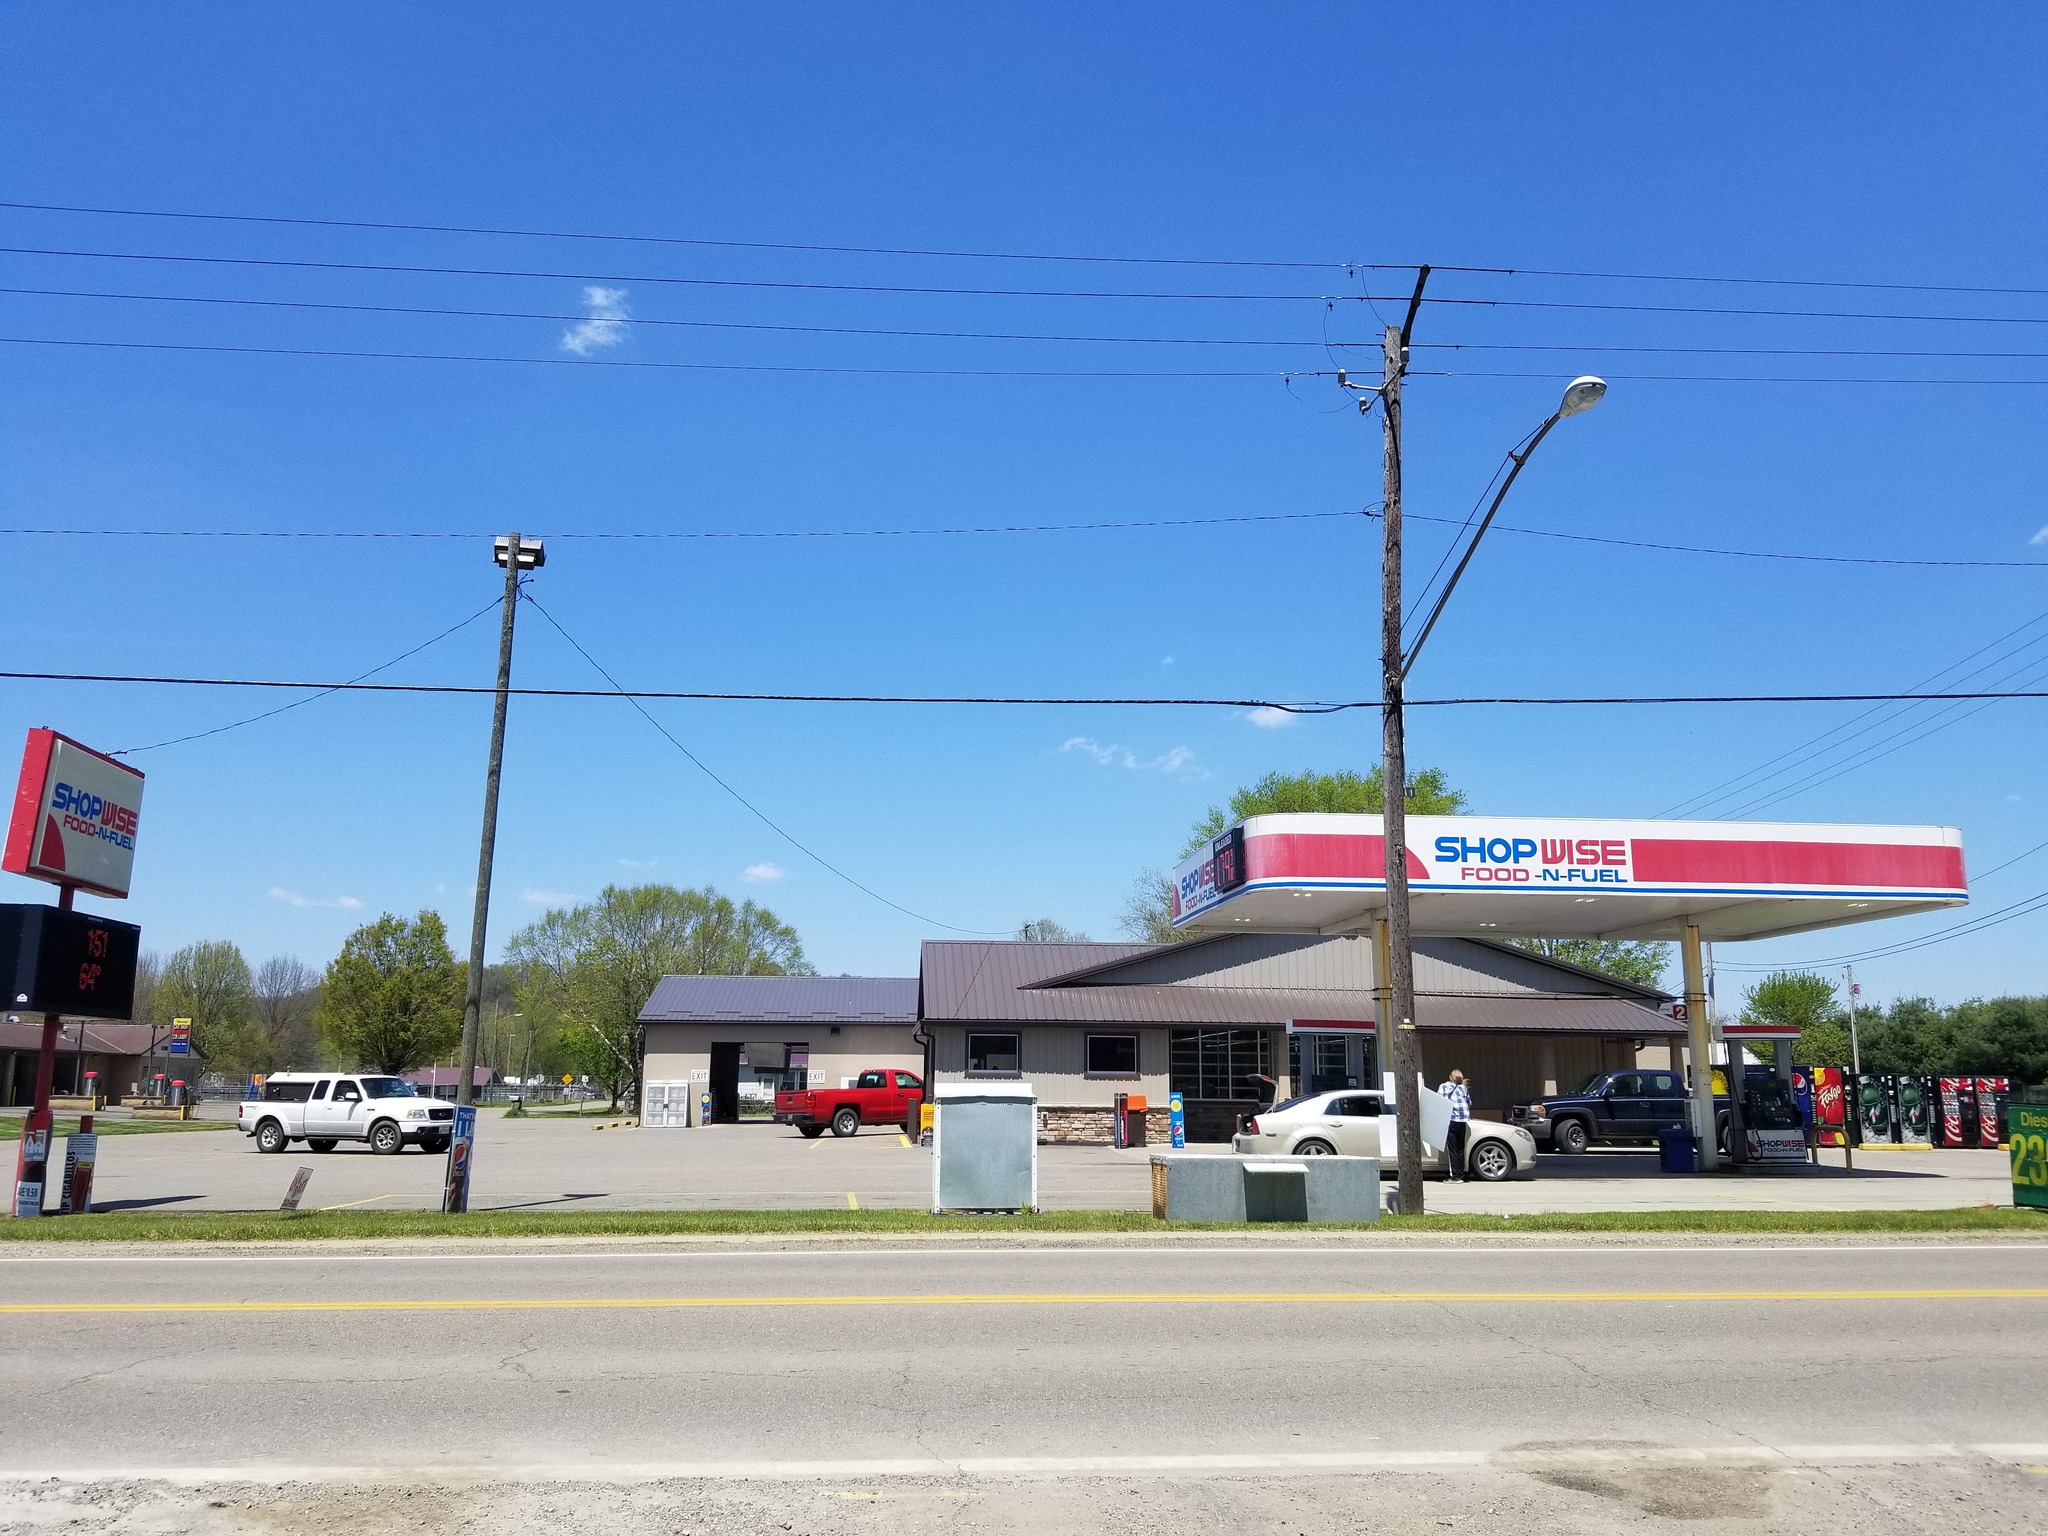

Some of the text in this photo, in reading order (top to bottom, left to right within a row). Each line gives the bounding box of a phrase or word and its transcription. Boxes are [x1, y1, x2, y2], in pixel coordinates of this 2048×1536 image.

[1461, 867, 1530, 881] FOOD
[1675, 1005, 1686, 1019] 2
[692, 1072, 708, 1081] EXIT
[808, 1072, 824, 1081] EXIT
[1818, 1085, 1841, 1109] Faygo
[2009, 1133, 2048, 1186] 23
[63, 1151, 76, 1199] CIGARILLOS
